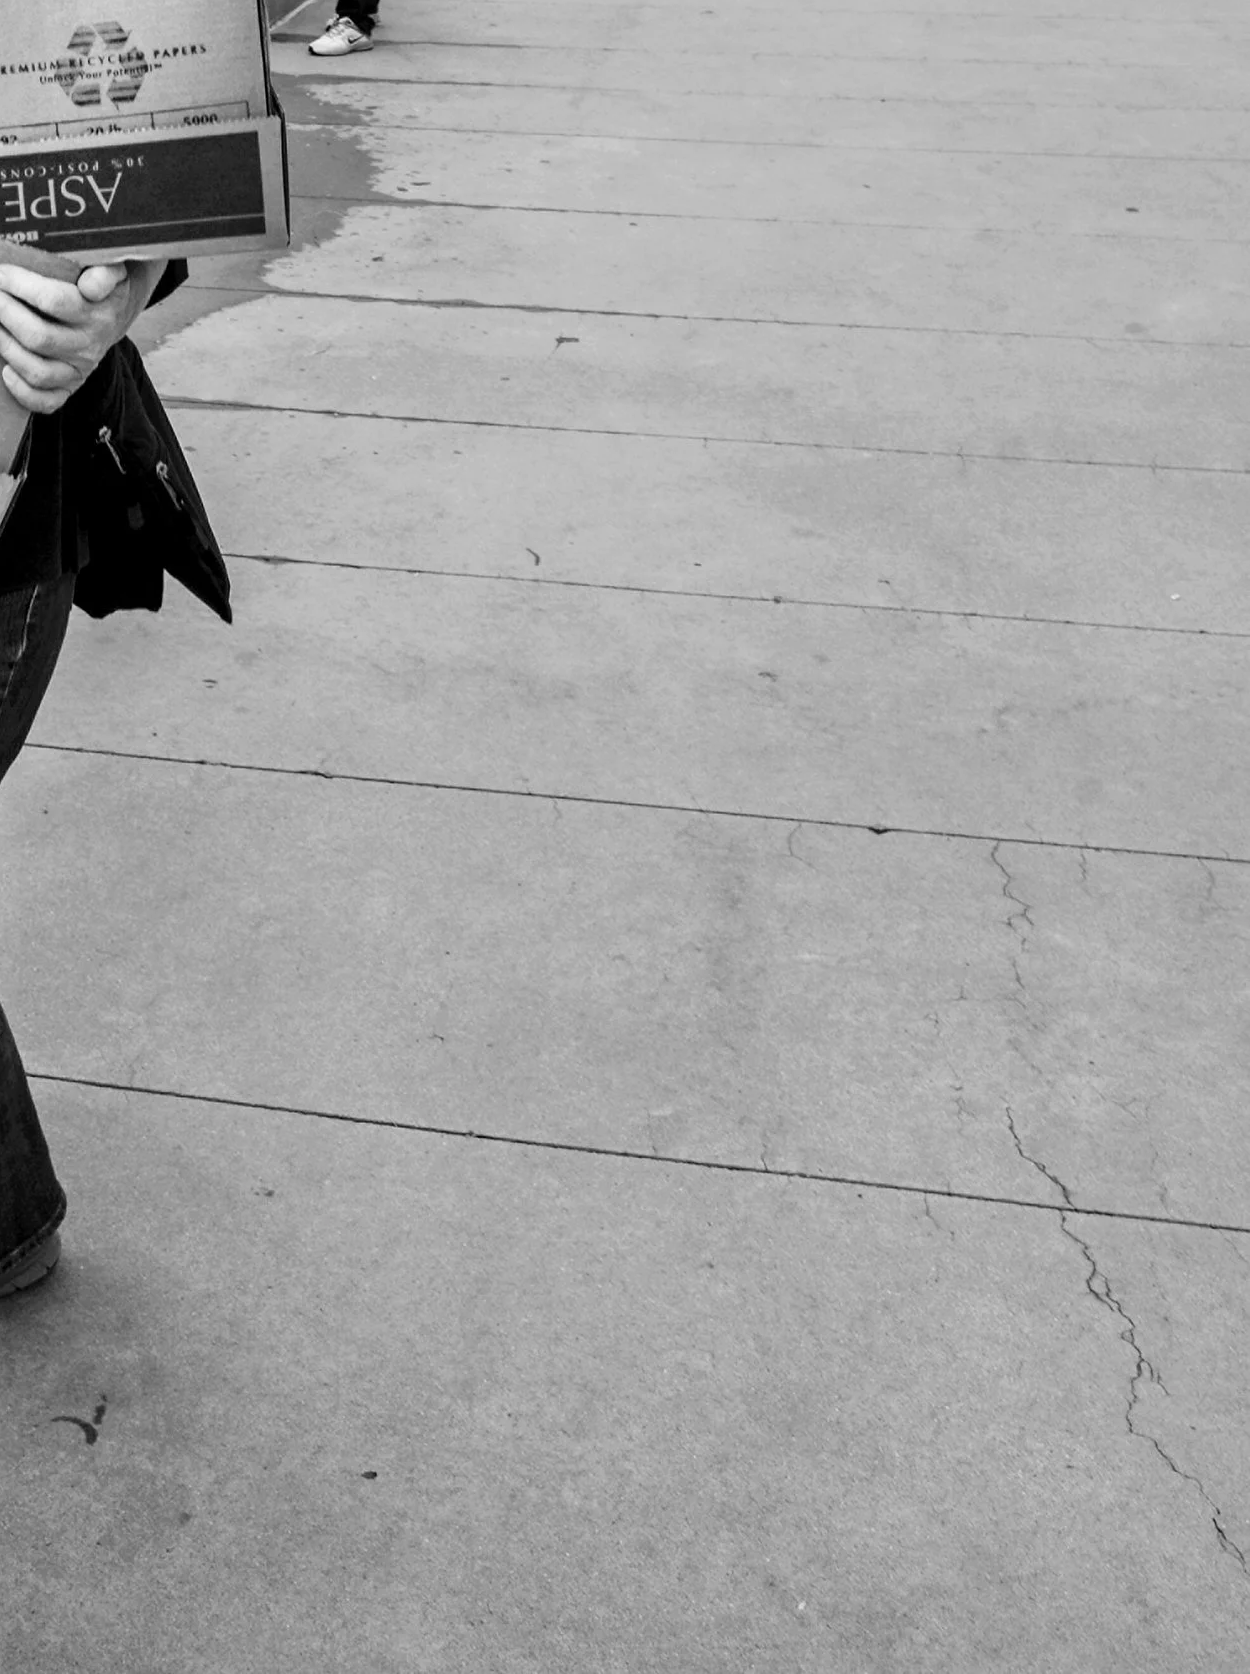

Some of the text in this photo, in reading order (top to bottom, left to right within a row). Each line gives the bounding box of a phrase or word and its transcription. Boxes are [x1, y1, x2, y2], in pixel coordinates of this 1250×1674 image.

[152, 44, 207, 60] PAPERS
[78, 68, 103, 80] Your
[111, 155, 145, 169] 30%
